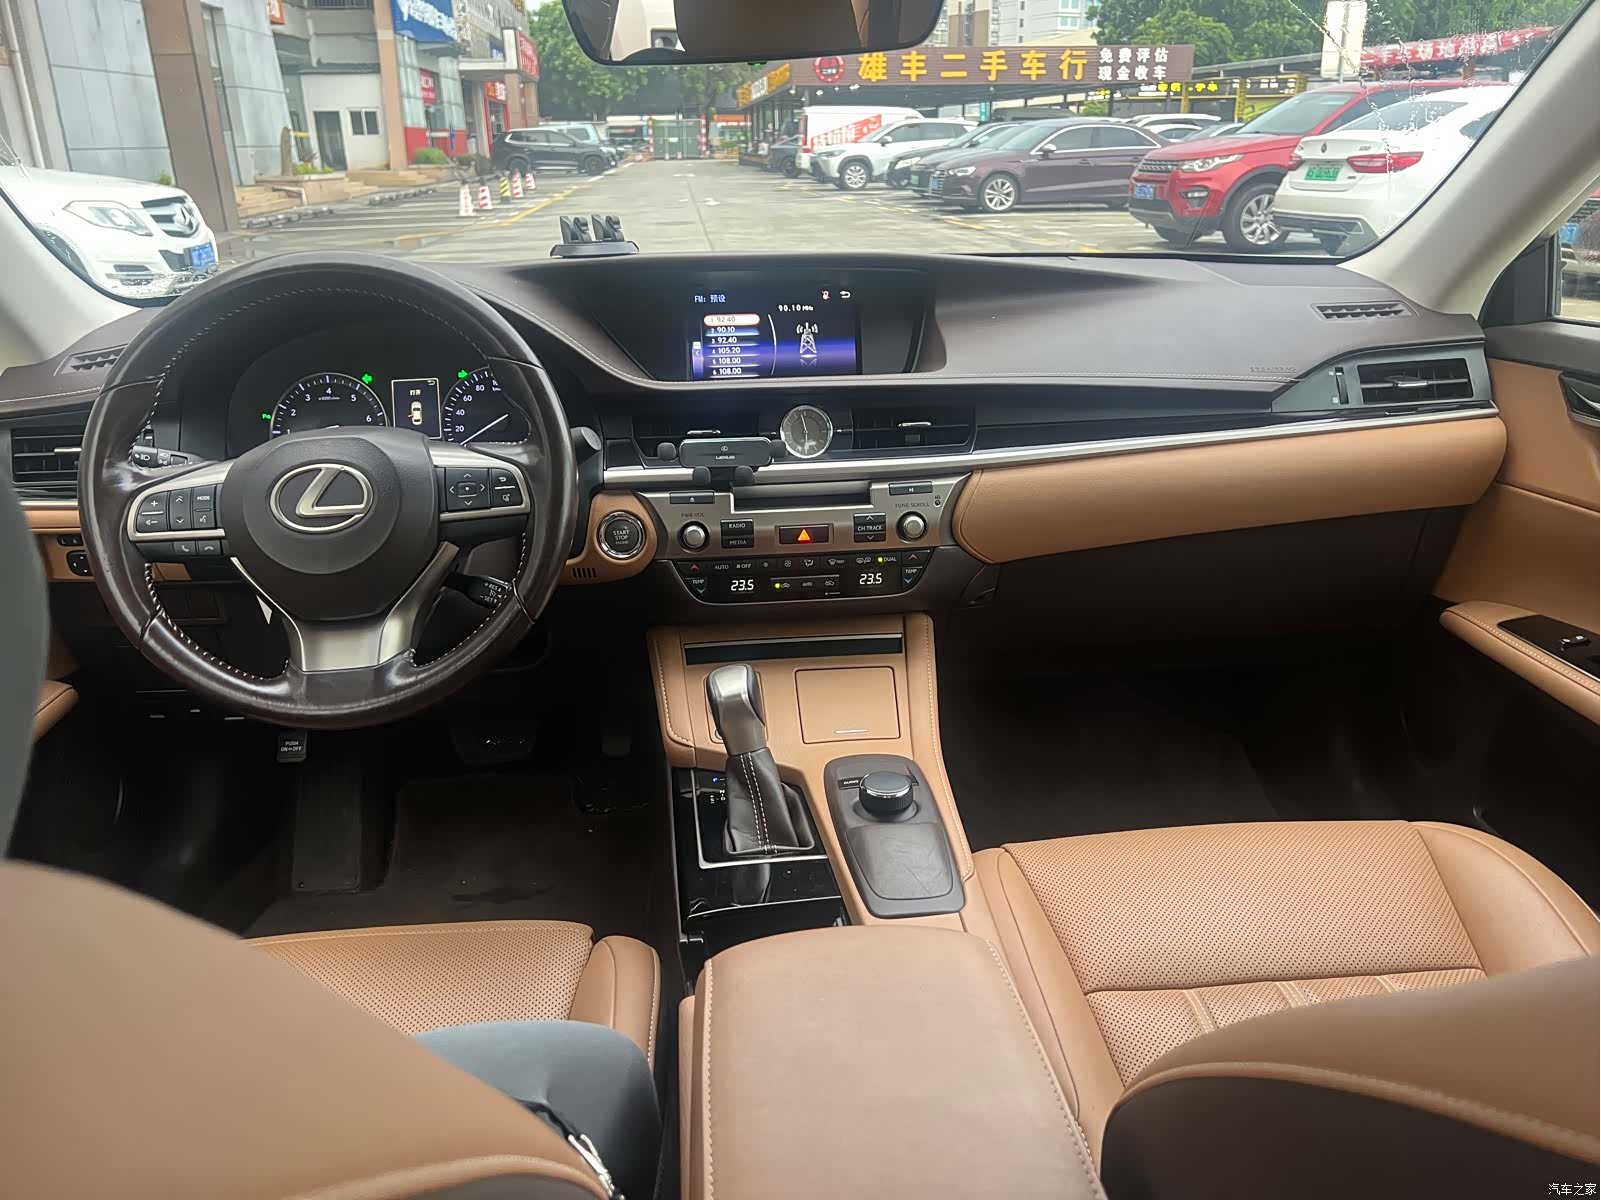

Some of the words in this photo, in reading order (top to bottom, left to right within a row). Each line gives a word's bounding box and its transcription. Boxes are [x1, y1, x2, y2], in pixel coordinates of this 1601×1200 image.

[1099, 47, 1169, 63] 免费评估
[858, 49, 1088, 82] 雄丰二手车行
[1098, 66, 1167, 81] 现金收车
[710, 294, 726, 303] 预设
[778, 304, 802, 312] 90.10
[455, 425, 465, 433] 20
[730, 579, 754, 591] 23.5
[859, 573, 883, 585] 23.5
